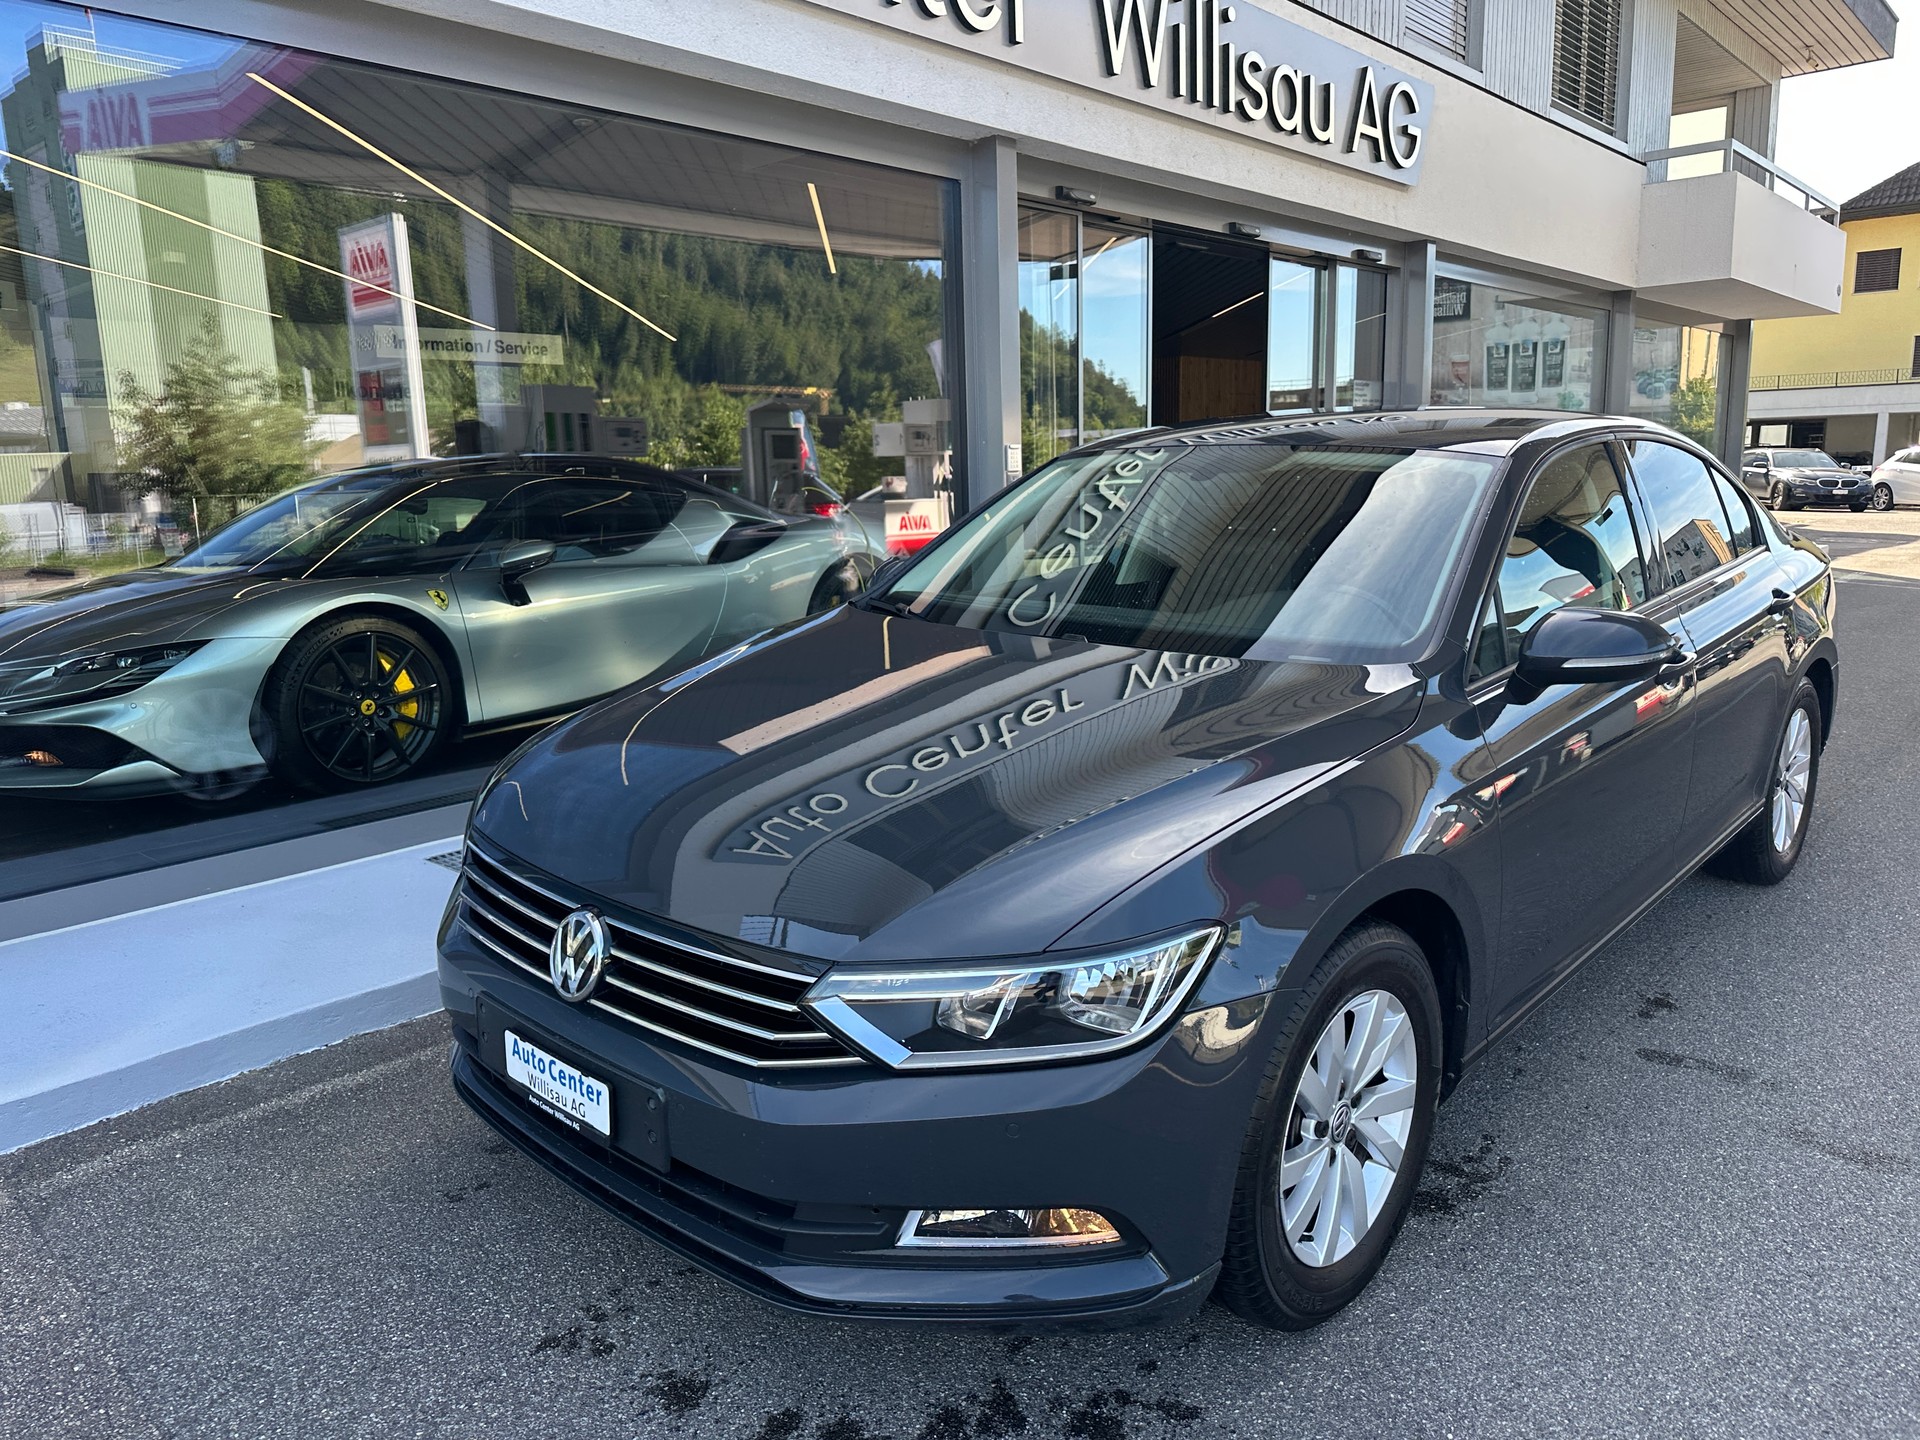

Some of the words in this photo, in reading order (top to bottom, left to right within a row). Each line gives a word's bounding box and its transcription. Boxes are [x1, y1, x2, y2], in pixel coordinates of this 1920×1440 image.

[1098, 0, 1335, 145] Willisau
[1347, 65, 1422, 169] AG
[393, 334, 484, 354] Inormation
[494, 339, 549, 356] Service
[527, 1071, 568, 1108] Willisau
[571, 1098, 586, 1119] AG
